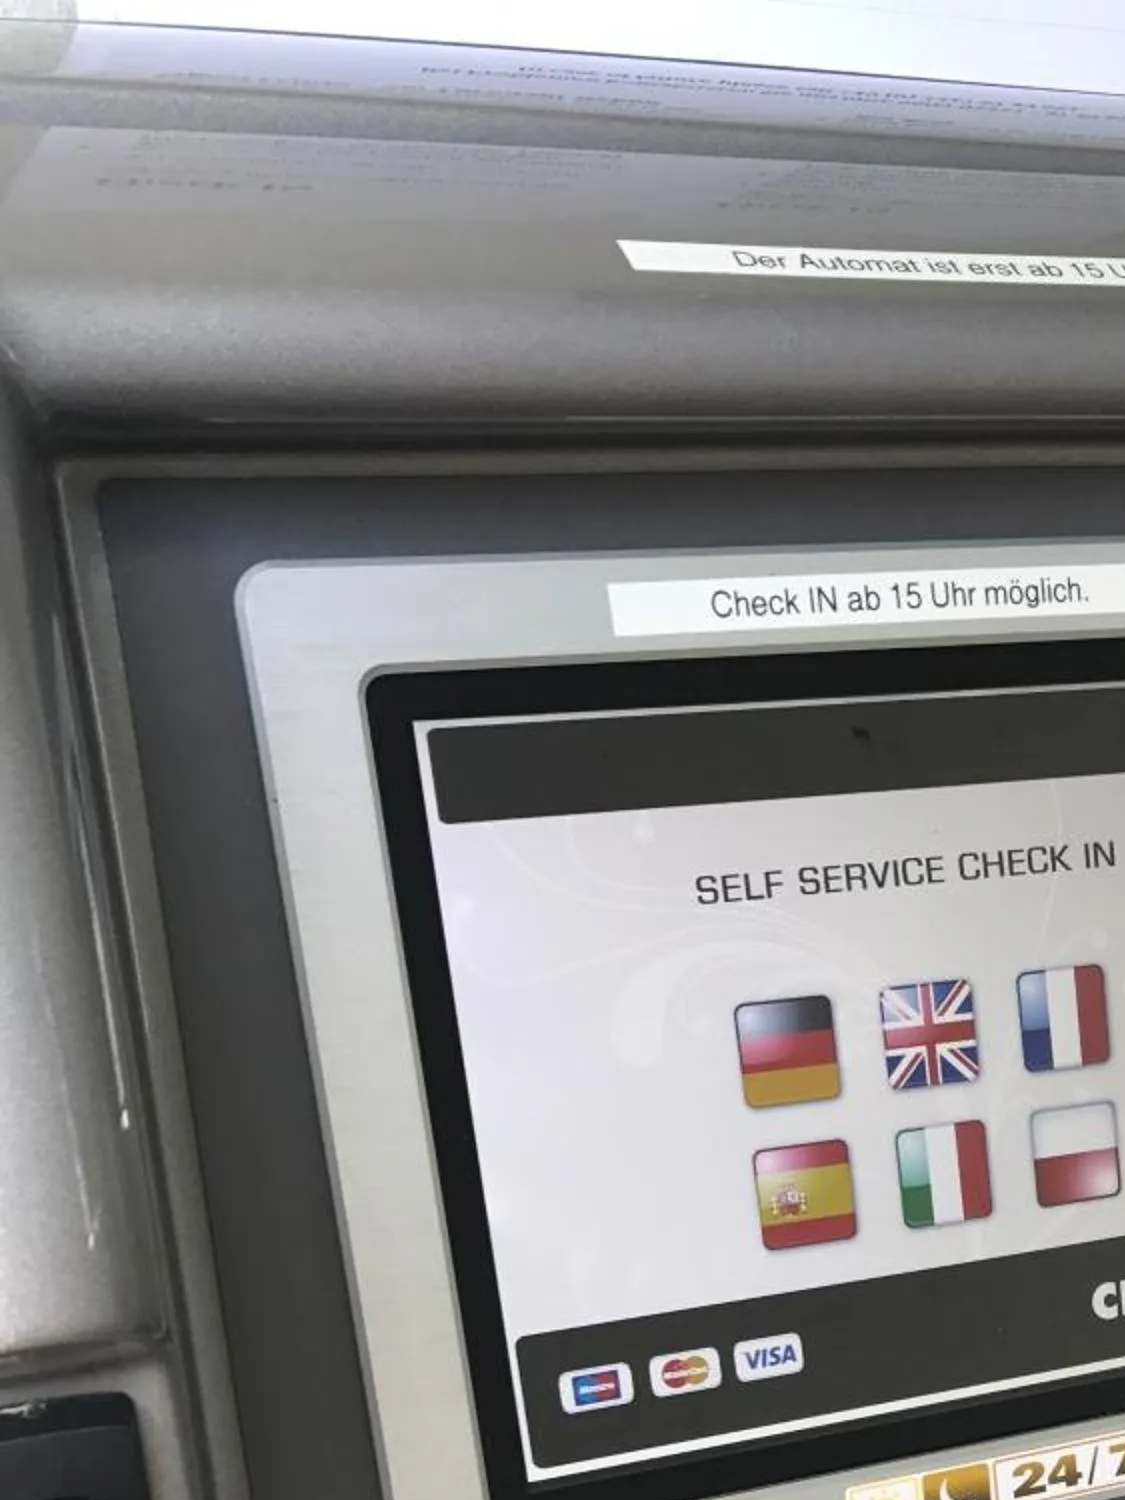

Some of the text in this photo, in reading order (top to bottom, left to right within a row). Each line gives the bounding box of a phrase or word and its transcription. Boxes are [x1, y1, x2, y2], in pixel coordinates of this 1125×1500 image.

[732, 250, 785, 269] Der
[799, 253, 922, 273] Automat
[927, 257, 958, 274] ist
[968, 261, 1023, 277] erst
[1027, 261, 1063, 278] ab
[1070, 262, 1104, 279] 15
[711, 576, 1089, 618] Check IN ab 15 Uhr möglich.
[695, 840, 1117, 904] SELF SERVICE CHECK IN
[743, 1344, 797, 1369] VISA
